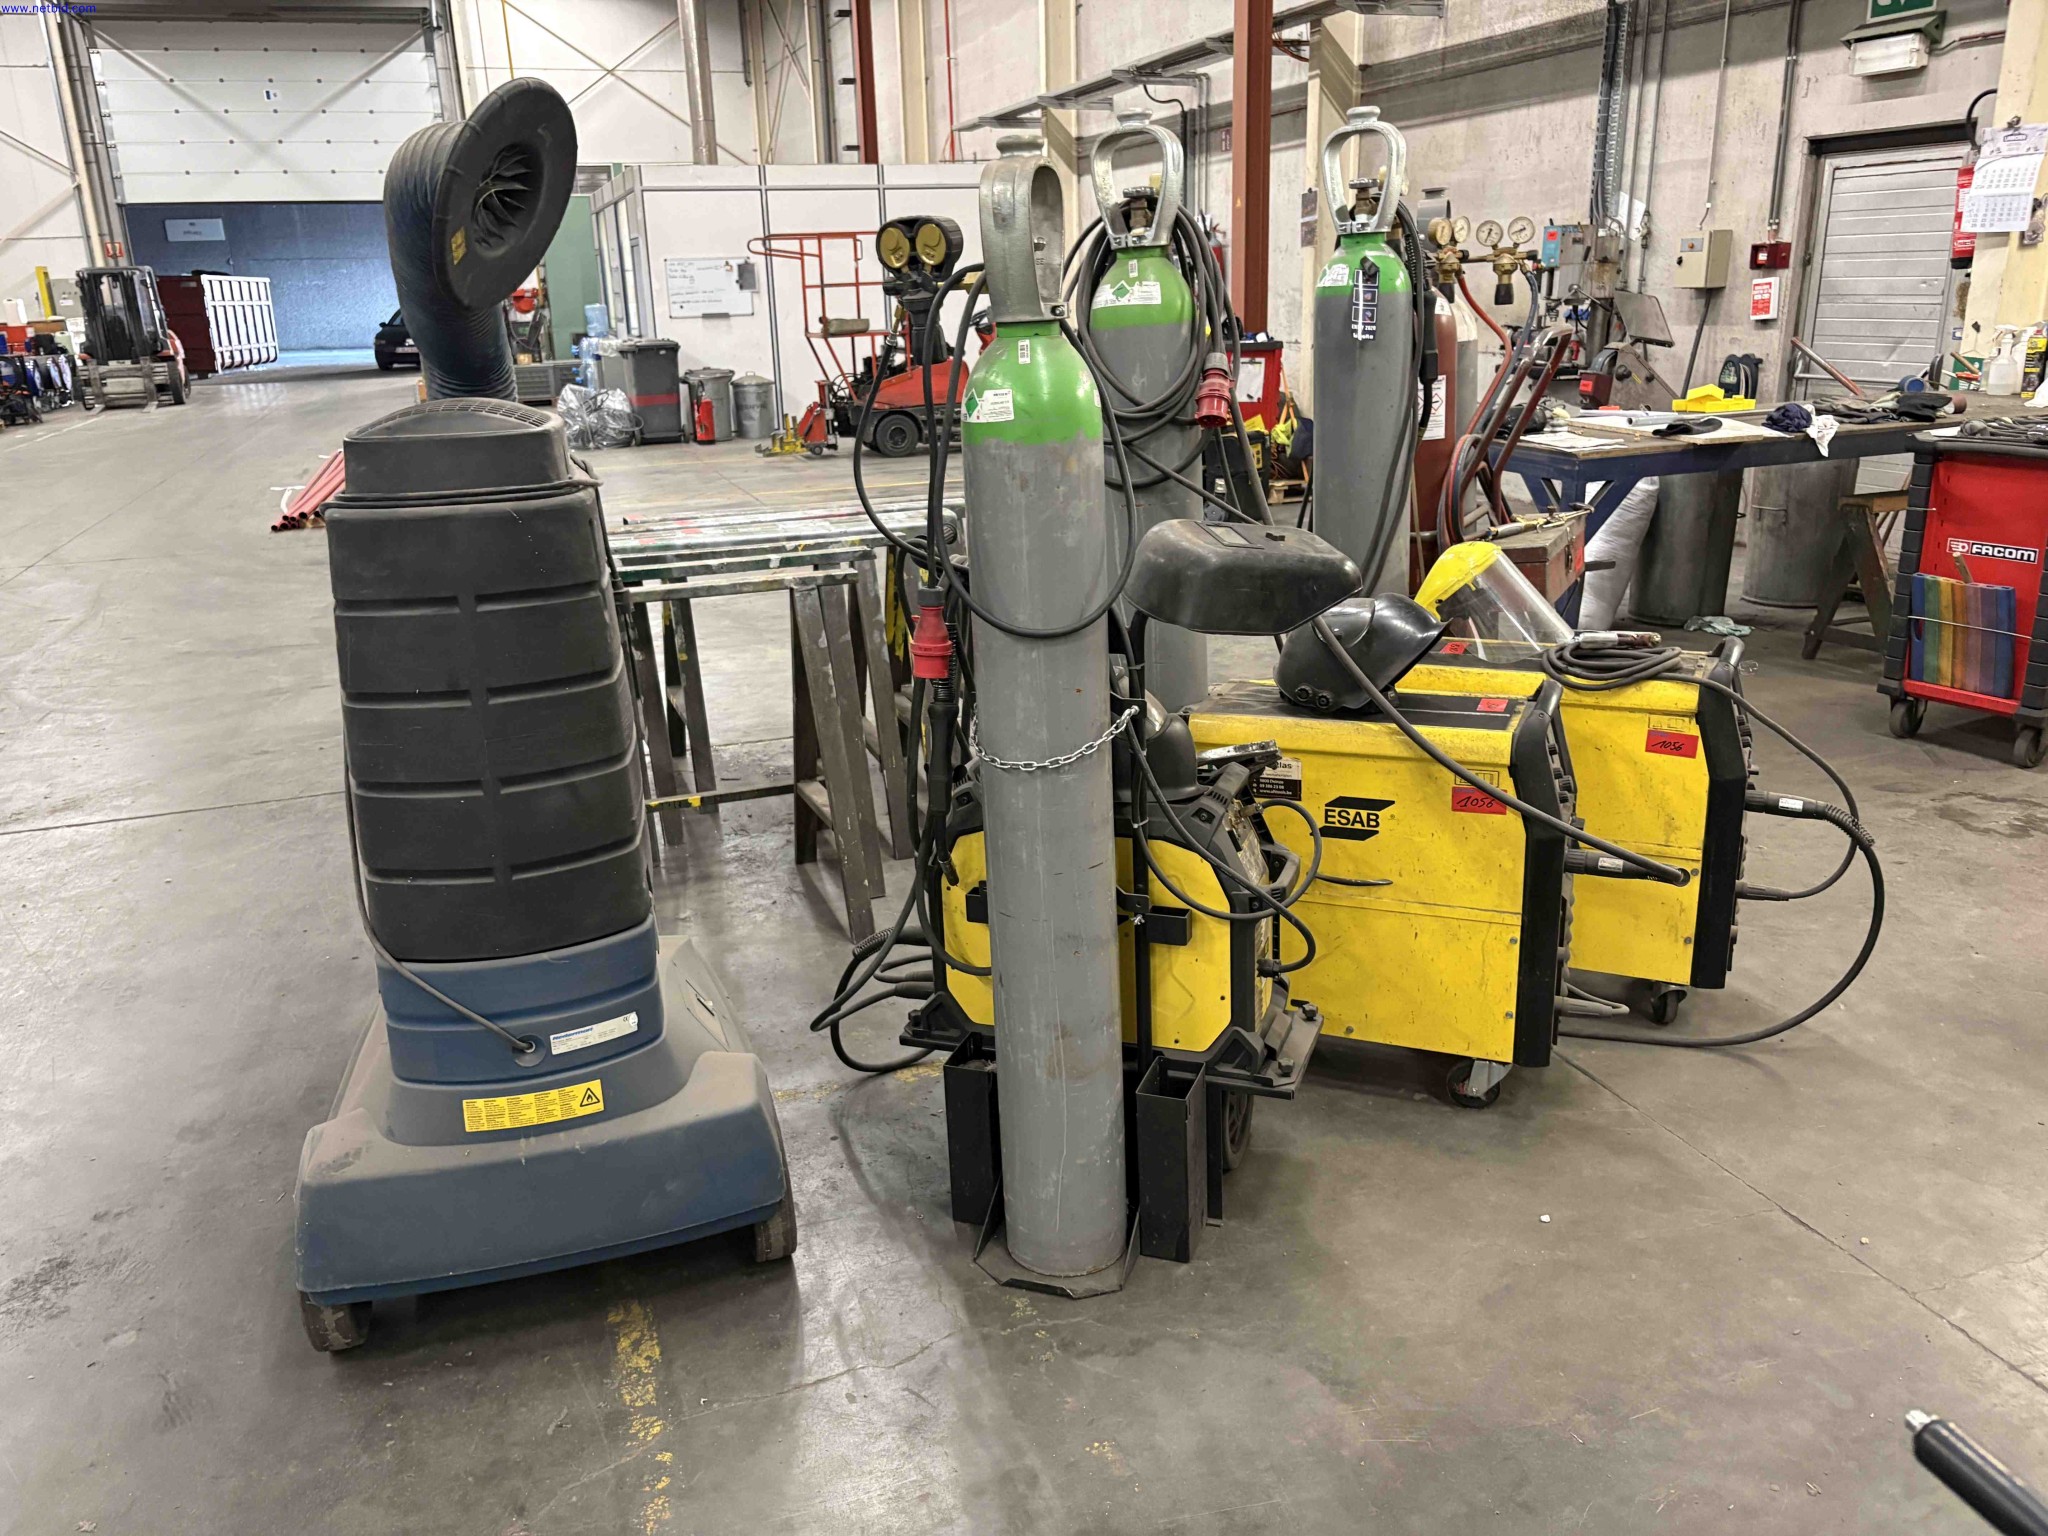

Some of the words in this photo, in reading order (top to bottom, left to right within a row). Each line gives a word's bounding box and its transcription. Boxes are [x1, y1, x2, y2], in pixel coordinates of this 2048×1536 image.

[1971, 544, 2036, 562] FACOM
[1652, 740, 1685, 751] 1056
[1456, 796, 1495, 808] 1056
[1324, 808, 1380, 828] ESAB
